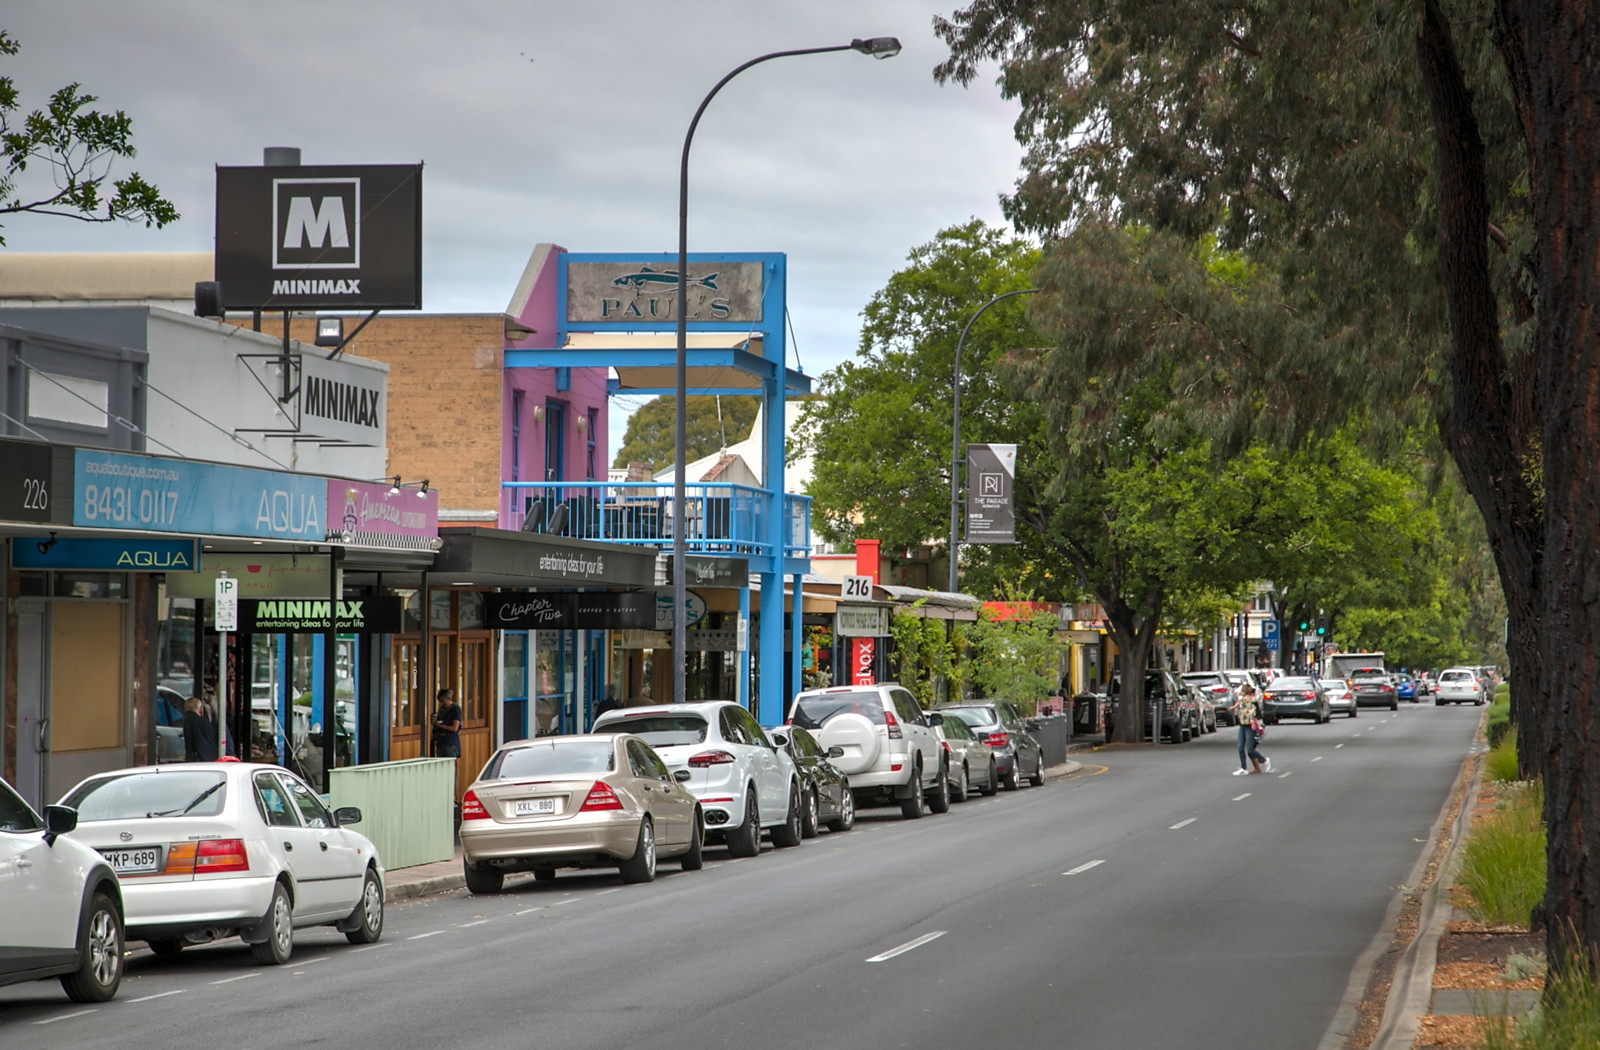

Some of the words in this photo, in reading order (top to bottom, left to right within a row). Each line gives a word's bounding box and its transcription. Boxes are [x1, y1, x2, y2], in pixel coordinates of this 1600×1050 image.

[283, 196, 349, 248] M
[272, 279, 361, 295] MINIMAX
[305, 375, 379, 429] MINIMAX
[85, 460, 180, 481] aquaboutique.com.au
[23, 478, 49, 510] 226
[84, 485, 132, 522] 8431
[139, 489, 179, 525] 0117
[255, 489, 320, 535] AQUA
[360, 491, 400, 528] American
[116, 551, 189, 566] AQUA
[220, 581, 233, 594] 1P
[846, 578, 869, 596] 216
[256, 601, 364, 618] MINIMAX
[499, 599, 552, 621] Chapter
[534, 609, 563, 623] Two
[256, 620, 300, 630] entertaining
[301, 619, 321, 628] ideas
[322, 619, 331, 628] fo
[353, 619, 364, 628] life
[1264, 622, 1276, 638] P
[517, 802, 532, 812] XKL
[134, 851, 155, 866] 689
